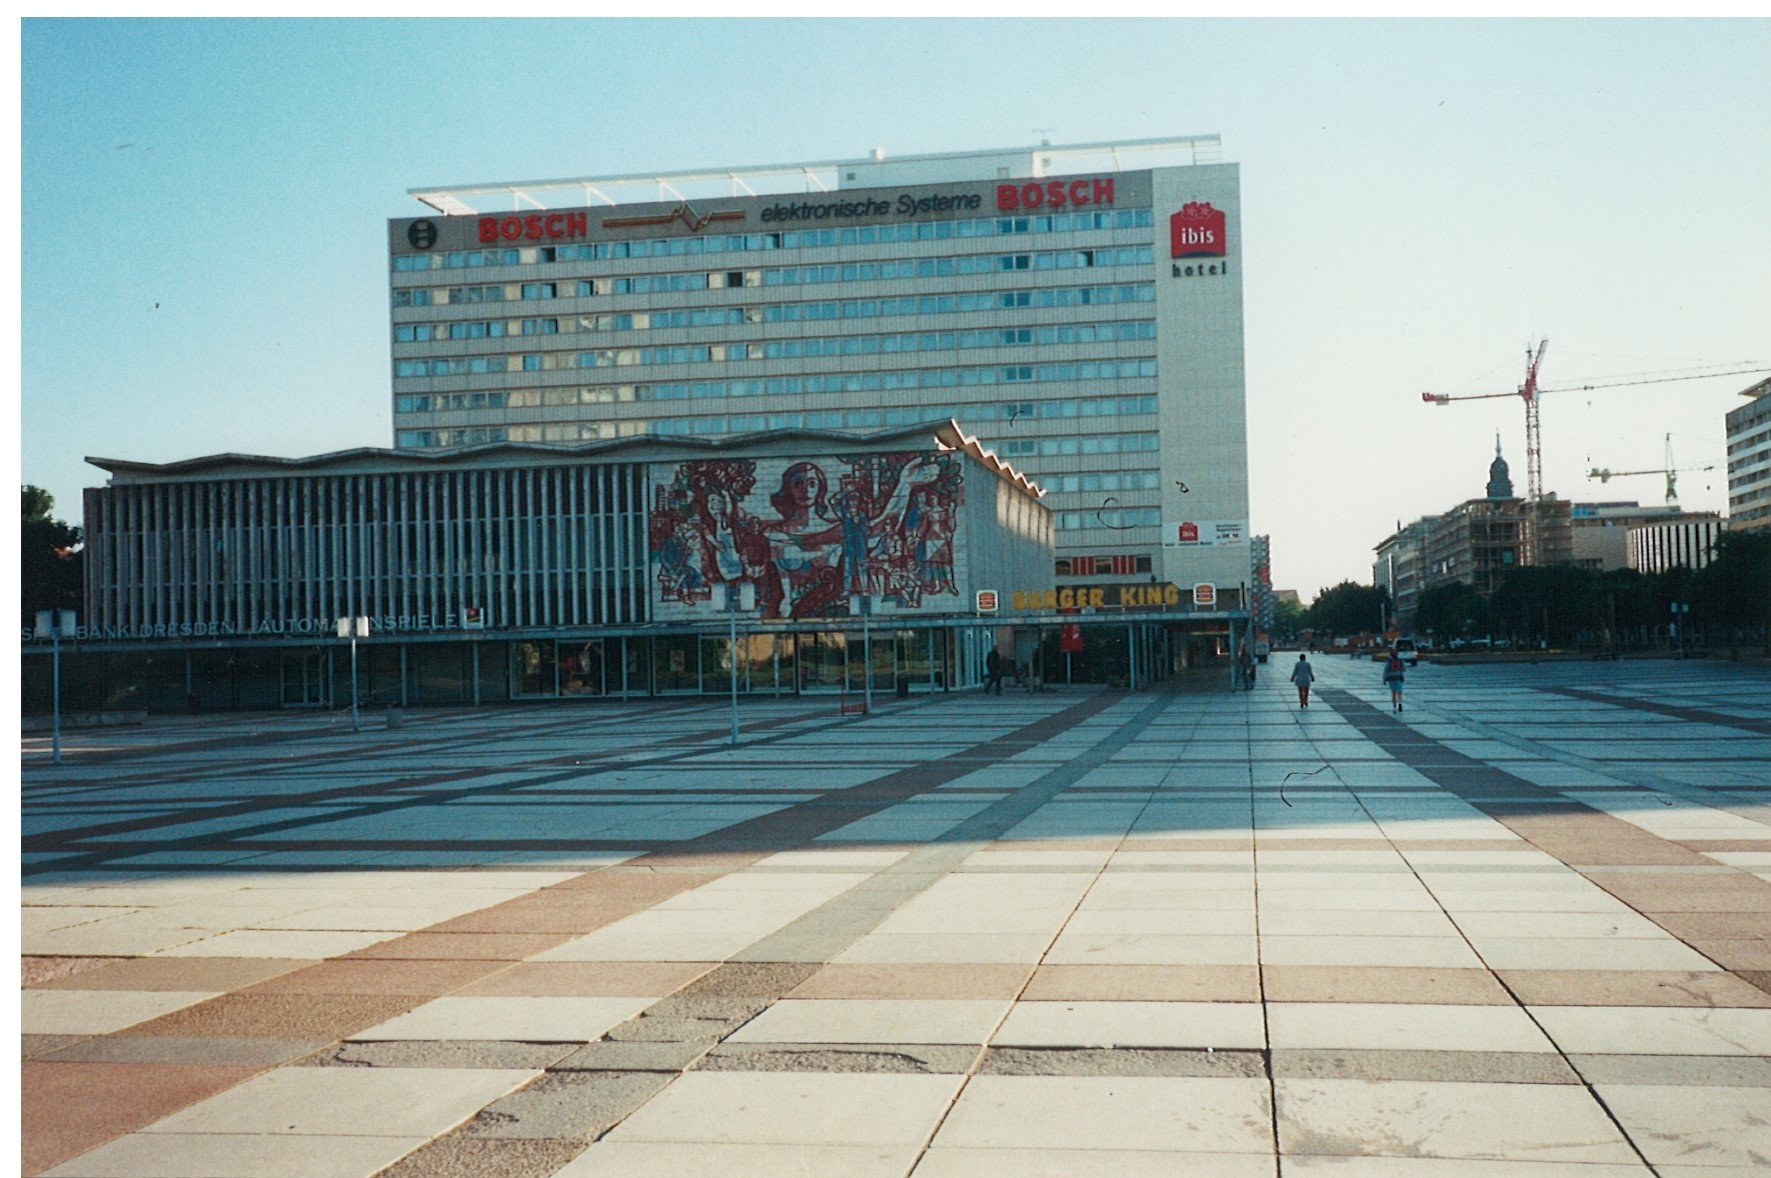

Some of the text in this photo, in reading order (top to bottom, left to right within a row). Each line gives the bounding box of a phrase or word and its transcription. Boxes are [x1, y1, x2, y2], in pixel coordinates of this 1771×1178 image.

[761, 193, 982, 222] elektronische Systeme
[996, 178, 1114, 211] BOSCH
[478, 212, 588, 243] BOSCH
[1181, 226, 1215, 245] ibis
[1172, 261, 1226, 278] hotel
[1012, 584, 1179, 611] BURGER KING
[21, 613, 457, 641] SBANK DRESDEN AUTOMANSPIELE
